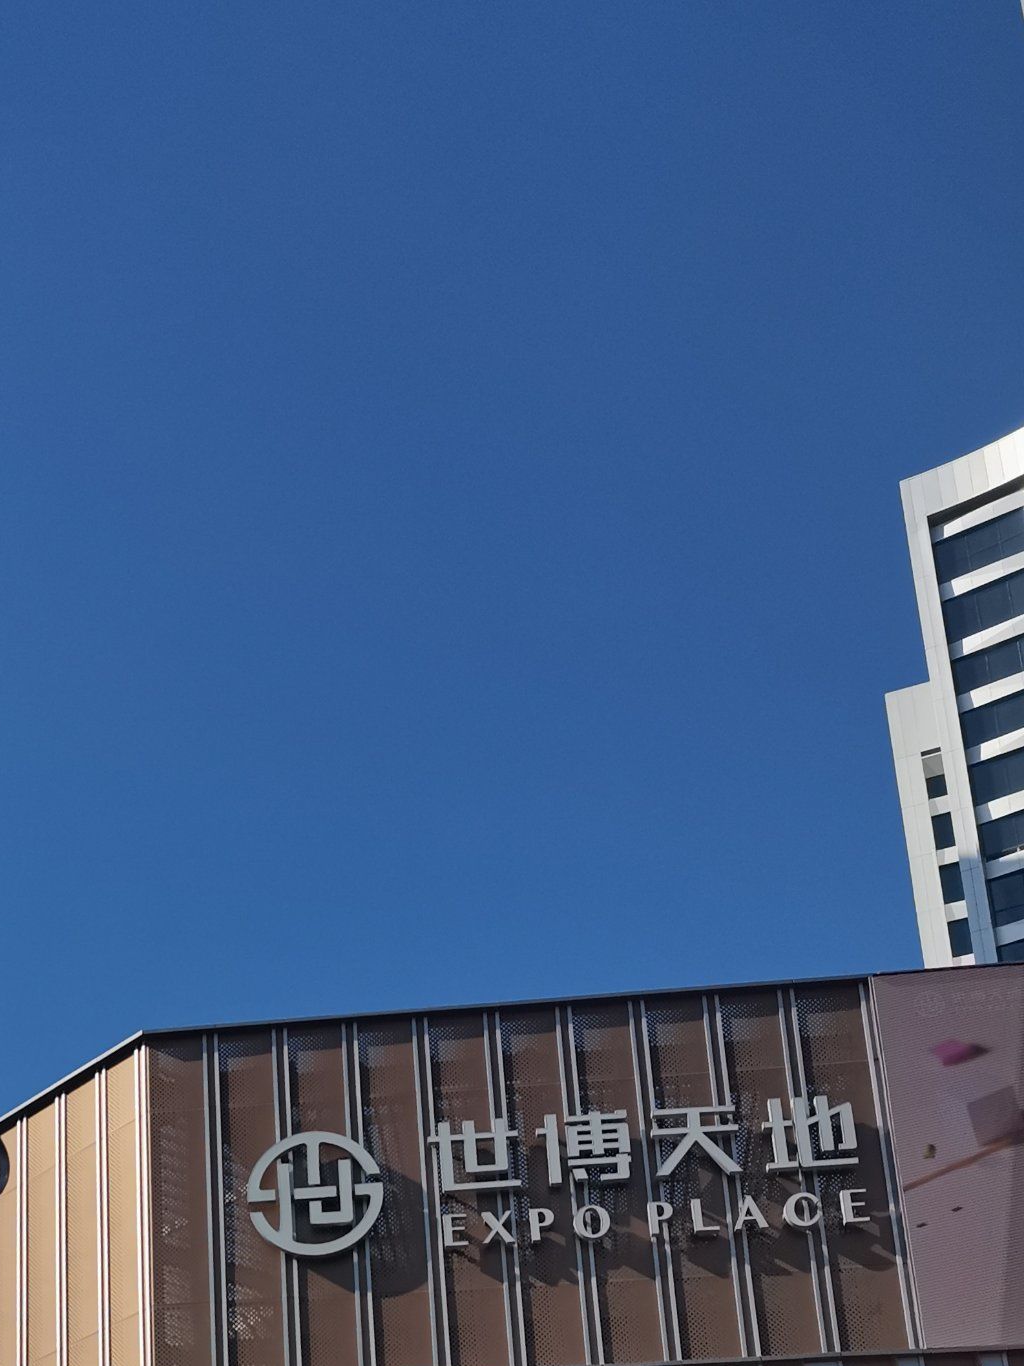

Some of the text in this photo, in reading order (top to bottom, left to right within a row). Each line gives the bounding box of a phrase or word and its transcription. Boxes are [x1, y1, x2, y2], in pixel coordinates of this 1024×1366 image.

[426, 1094, 859, 1194] 世博天地
[441, 1188, 871, 1248] EXPO PLACE
